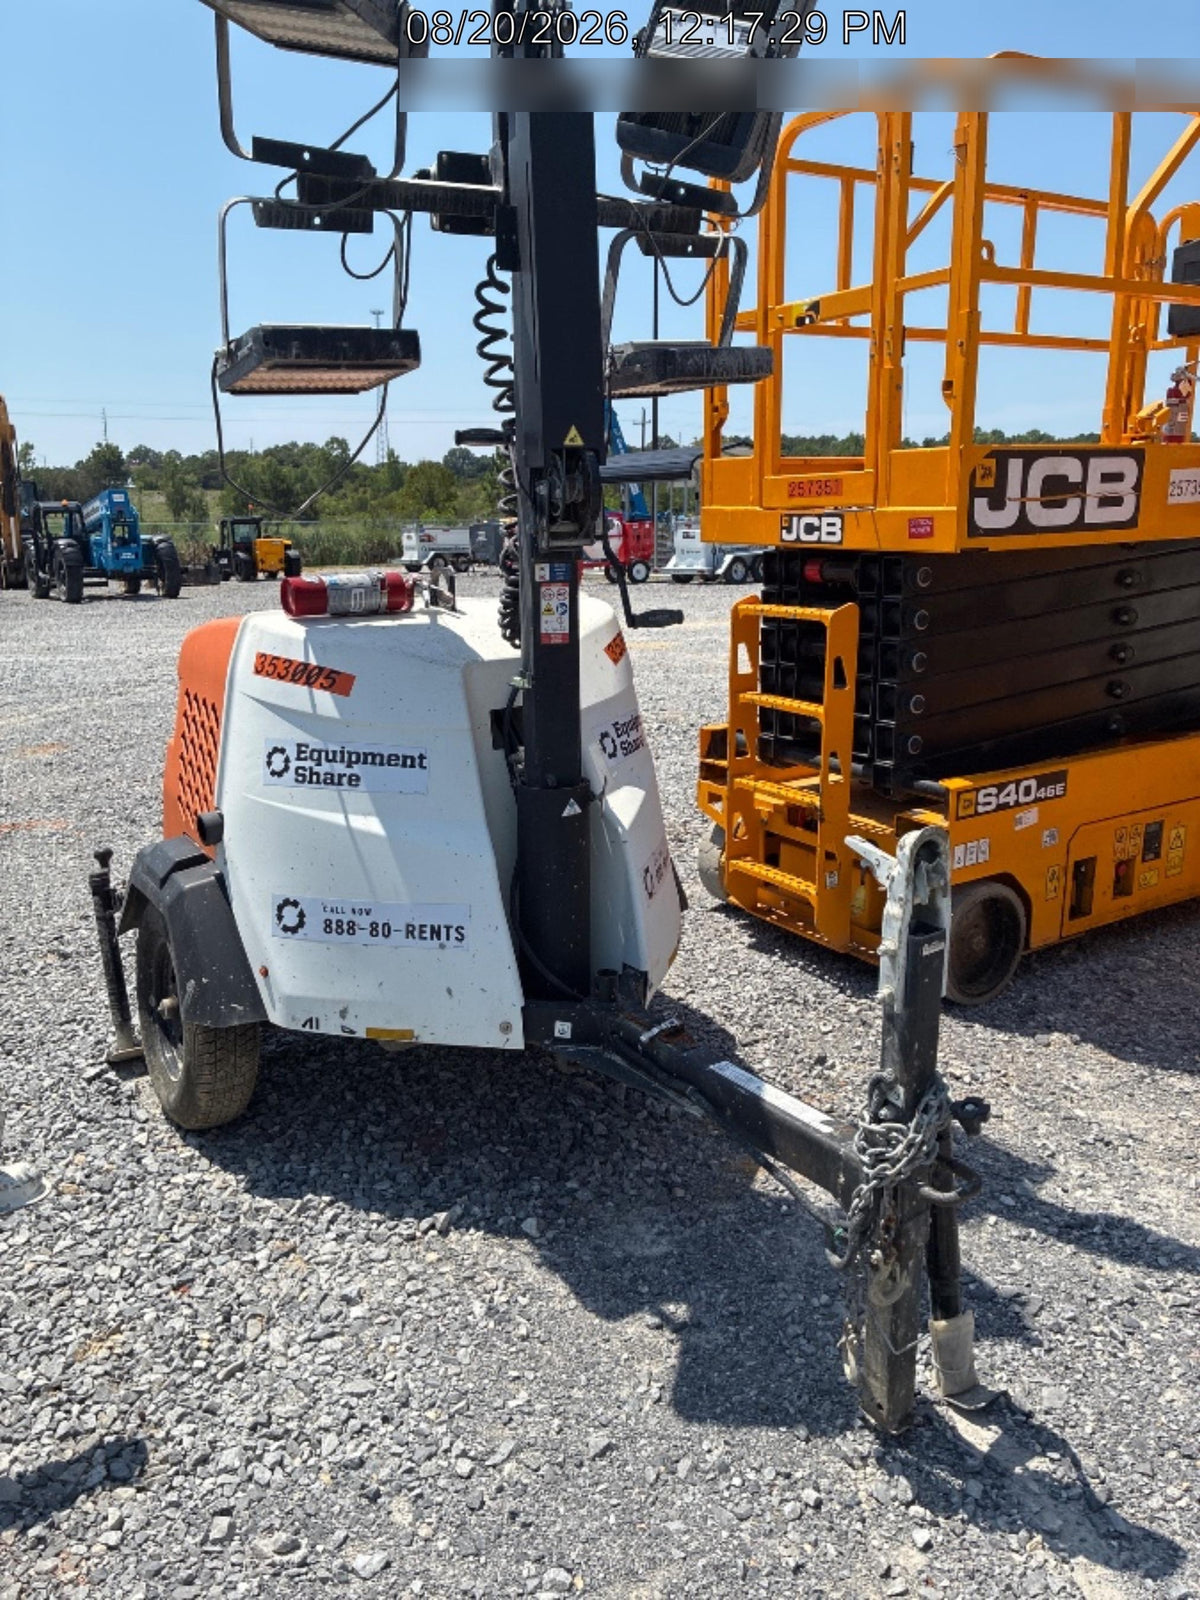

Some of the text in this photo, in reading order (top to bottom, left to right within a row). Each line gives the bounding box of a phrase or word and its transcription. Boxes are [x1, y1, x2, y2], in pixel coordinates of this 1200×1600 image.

[973, 456, 1139, 529] JCB
[782, 516, 842, 542] JCB
[255, 653, 342, 691] 353005
[295, 742, 428, 770] Equipment
[294, 766, 361, 787] Share
[322, 905, 372, 917] CALL NOW
[322, 917, 466, 943] 888-80-RENTS
